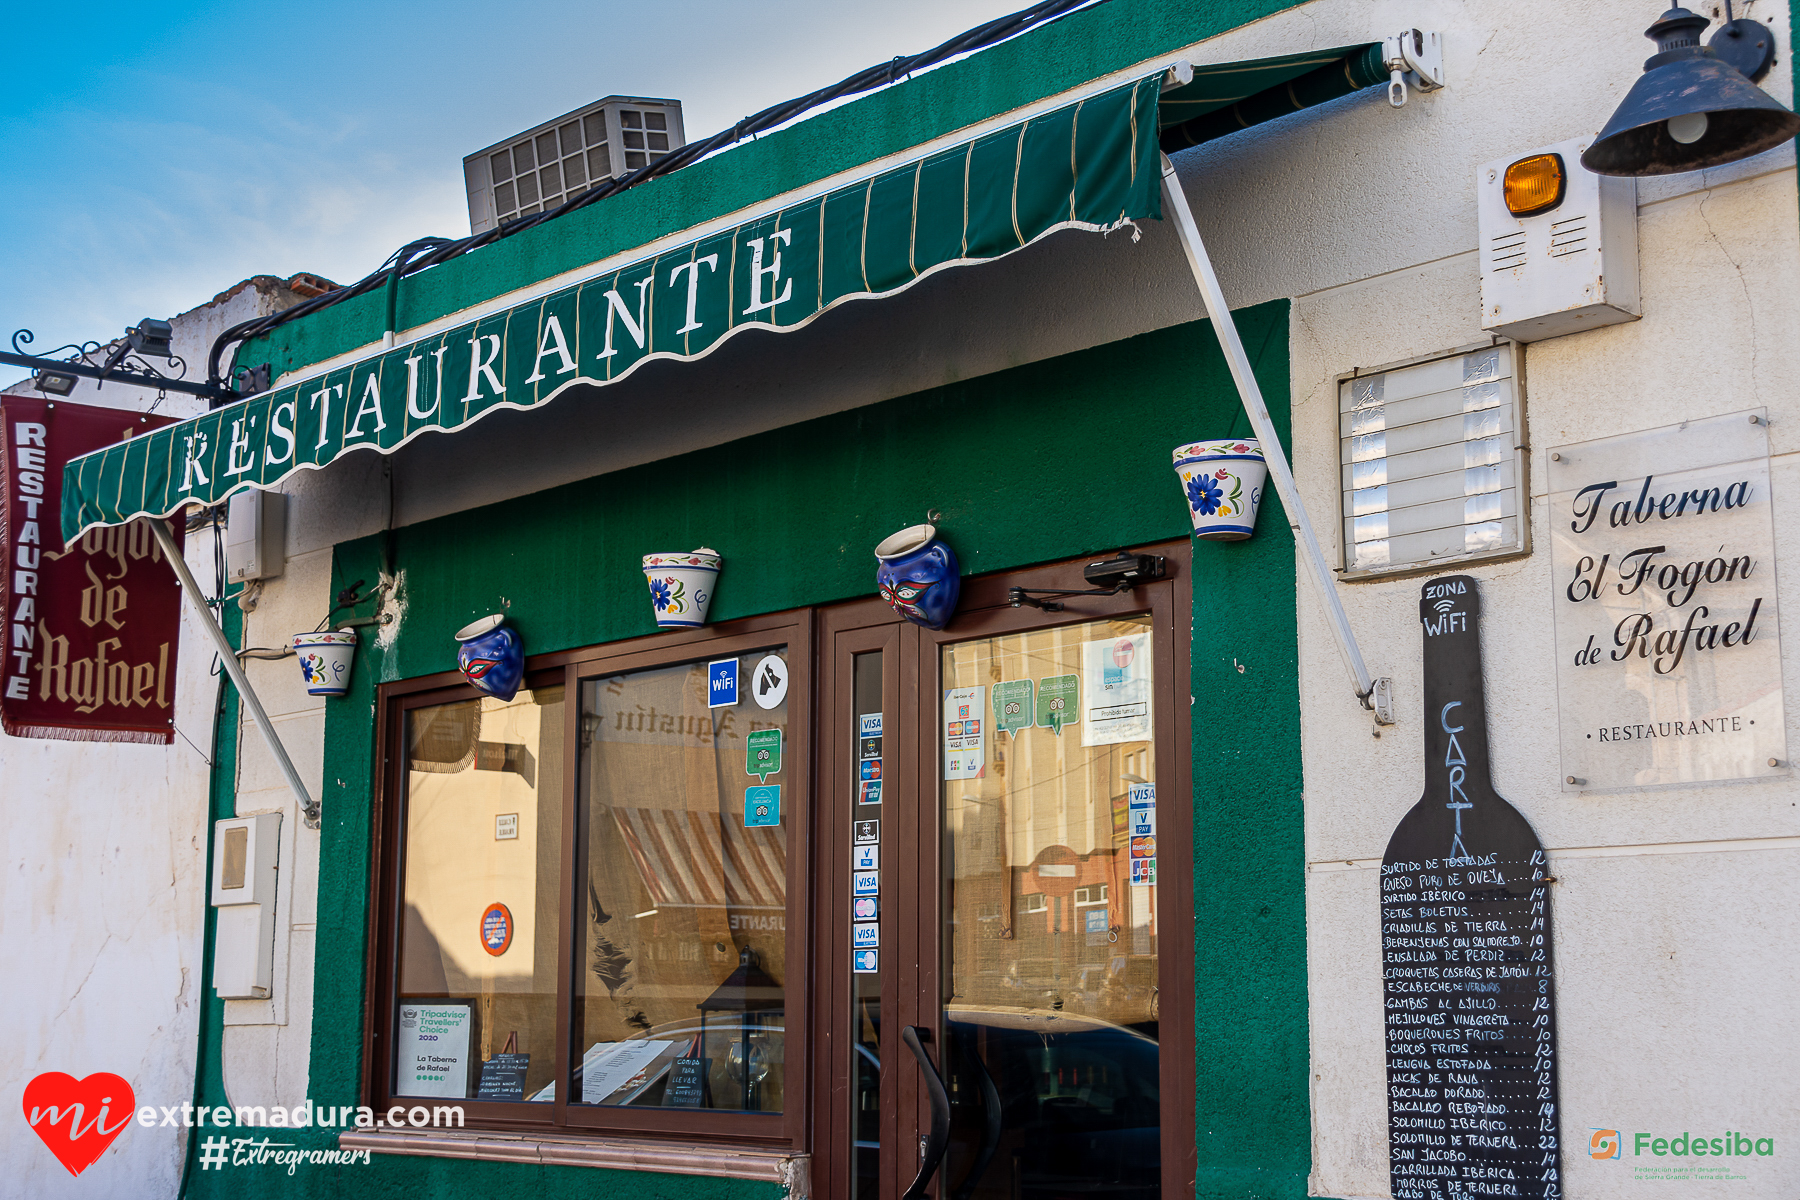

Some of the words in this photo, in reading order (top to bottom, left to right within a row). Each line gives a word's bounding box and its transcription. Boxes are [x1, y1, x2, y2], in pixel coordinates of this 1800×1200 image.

[178, 228, 792, 492] RESTAURANTE
[1570, 475, 1753, 533] Taberna
[6, 422, 46, 700] RESTAURANTE
[1567, 554, 1610, 602] El
[1617, 544, 1758, 608] Fogón
[80, 560, 128, 630] de
[1426, 580, 1467, 599] ZONA
[1574, 635, 1601, 666] de
[1610, 598, 1762, 674] Rafael
[34, 617, 169, 713] Rafael
[864, 719, 882, 729] VISA
[1599, 716, 1742, 742] RESTAURANTE
[1441, 701, 1473, 862] CARTA
[1133, 788, 1155, 800] VISA
[1380, 862, 1421, 875] SURTIDO
[1426, 859, 1438, 869] DE
[1442, 852, 1497, 868] TOSTADAS
[1530, 850, 1546, 866] 12
[1133, 867, 1155, 876] JCB
[858, 877, 876, 887] VISA
[1384, 876, 1412, 891] QUESO
[1419, 875, 1442, 888] PURO
[1448, 873, 1462, 886] DE
[1467, 868, 1505, 884] OVEJA
[1532, 868, 1542, 881] 10
[1384, 892, 1416, 904] SURTIDO
[1530, 888, 1544, 901] 14
[1384, 908, 1413, 920] SETAS
[1419, 906, 1468, 918] BOLETUS
[1530, 901, 1544, 914] 14
[1383, 922, 1437, 934] CRIADILLAS
[1444, 921, 1458, 932] DE
[1464, 921, 1507, 932] TIERRA
[1530, 917, 1544, 930] 14
[858, 929, 876, 939] VISA
[1384, 936, 1449, 949] BERENJENAS
[1453, 938, 1469, 948] CON
[1472, 935, 1520, 948] SALMOREJO
[1530, 934, 1543, 947] 10
[1387, 951, 1437, 962] ENSALADA
[1444, 950, 1460, 960] DE
[1464, 949, 1504, 961] PERDIZ
[1530, 949, 1546, 961] 12
[1386, 967, 1439, 979] CROQUETAS
[1443, 966, 1482, 979] CASERAS
[1486, 967, 1497, 978] DE
[1535, 965, 1552, 976] 12
[1388, 981, 1452, 992] ESCABECHE
[1538, 980, 1548, 994] 8
[1387, 998, 1428, 1010] GAMBAS
[1438, 999, 1452, 1009] AL
[1459, 997, 1496, 1010] AJILLO
[1532, 997, 1549, 1011] 12
[420, 1010, 467, 1019] Tripadvisor
[420, 1018, 462, 1026] Travellers'
[1388, 1012, 1446, 1025] MEJILLONES
[1453, 1014, 1509, 1025] VINAGRETA
[1532, 1014, 1548, 1028] 10
[419, 1026, 449, 1034] Choice
[1388, 1028, 1460, 1040] BOQUERONES
[1465, 1028, 1504, 1040] FRITOS
[1536, 1028, 1550, 1042] 10
[1391, 1043, 1426, 1054] CHOCOS
[1430, 1044, 1468, 1054] FRITOS
[1535, 1043, 1552, 1057] 12
[1392, 1059, 1431, 1069] LENGUA
[1436, 1059, 1491, 1069] ESTOFADA
[1534, 1057, 1551, 1072] 10
[1392, 1073, 1421, 1084] ANCAS
[1428, 1073, 1442, 1084] DE
[1448, 1072, 1478, 1084] RANA
[1537, 1072, 1550, 1085] 12
[1391, 1086, 1437, 1098] BACALAO
[1444, 1086, 1484, 1098] DORADO
[1536, 1086, 1552, 1099] 12
[1392, 1101, 1442, 1113] BACALAO
[1448, 1102, 1506, 1114] REBOZADO
[1392, 1117, 1446, 1129] SOLOMILLO
[1540, 1118, 1555, 1131] 12
[1392, 1132, 1446, 1145] SOLOMILLO
[1450, 1135, 1462, 1146] DE
[1466, 1134, 1516, 1149] TERNERA
[1538, 1135, 1557, 1149] 22
[1392, 1148, 1414, 1160] SAN
[1421, 1148, 1466, 1161] JACOBO
[1541, 1152, 1555, 1166] 14
[1393, 1164, 1457, 1176] CARRILLADA
[1396, 1178, 1438, 1189] MORROS
[1448, 1181, 1461, 1192] DE
[1466, 1182, 1518, 1195] TERNERA
[1543, 1183, 1561, 1198] 12
[1398, 1189, 1423, 1199] RABO
[1430, 1190, 1444, 1200] DE
